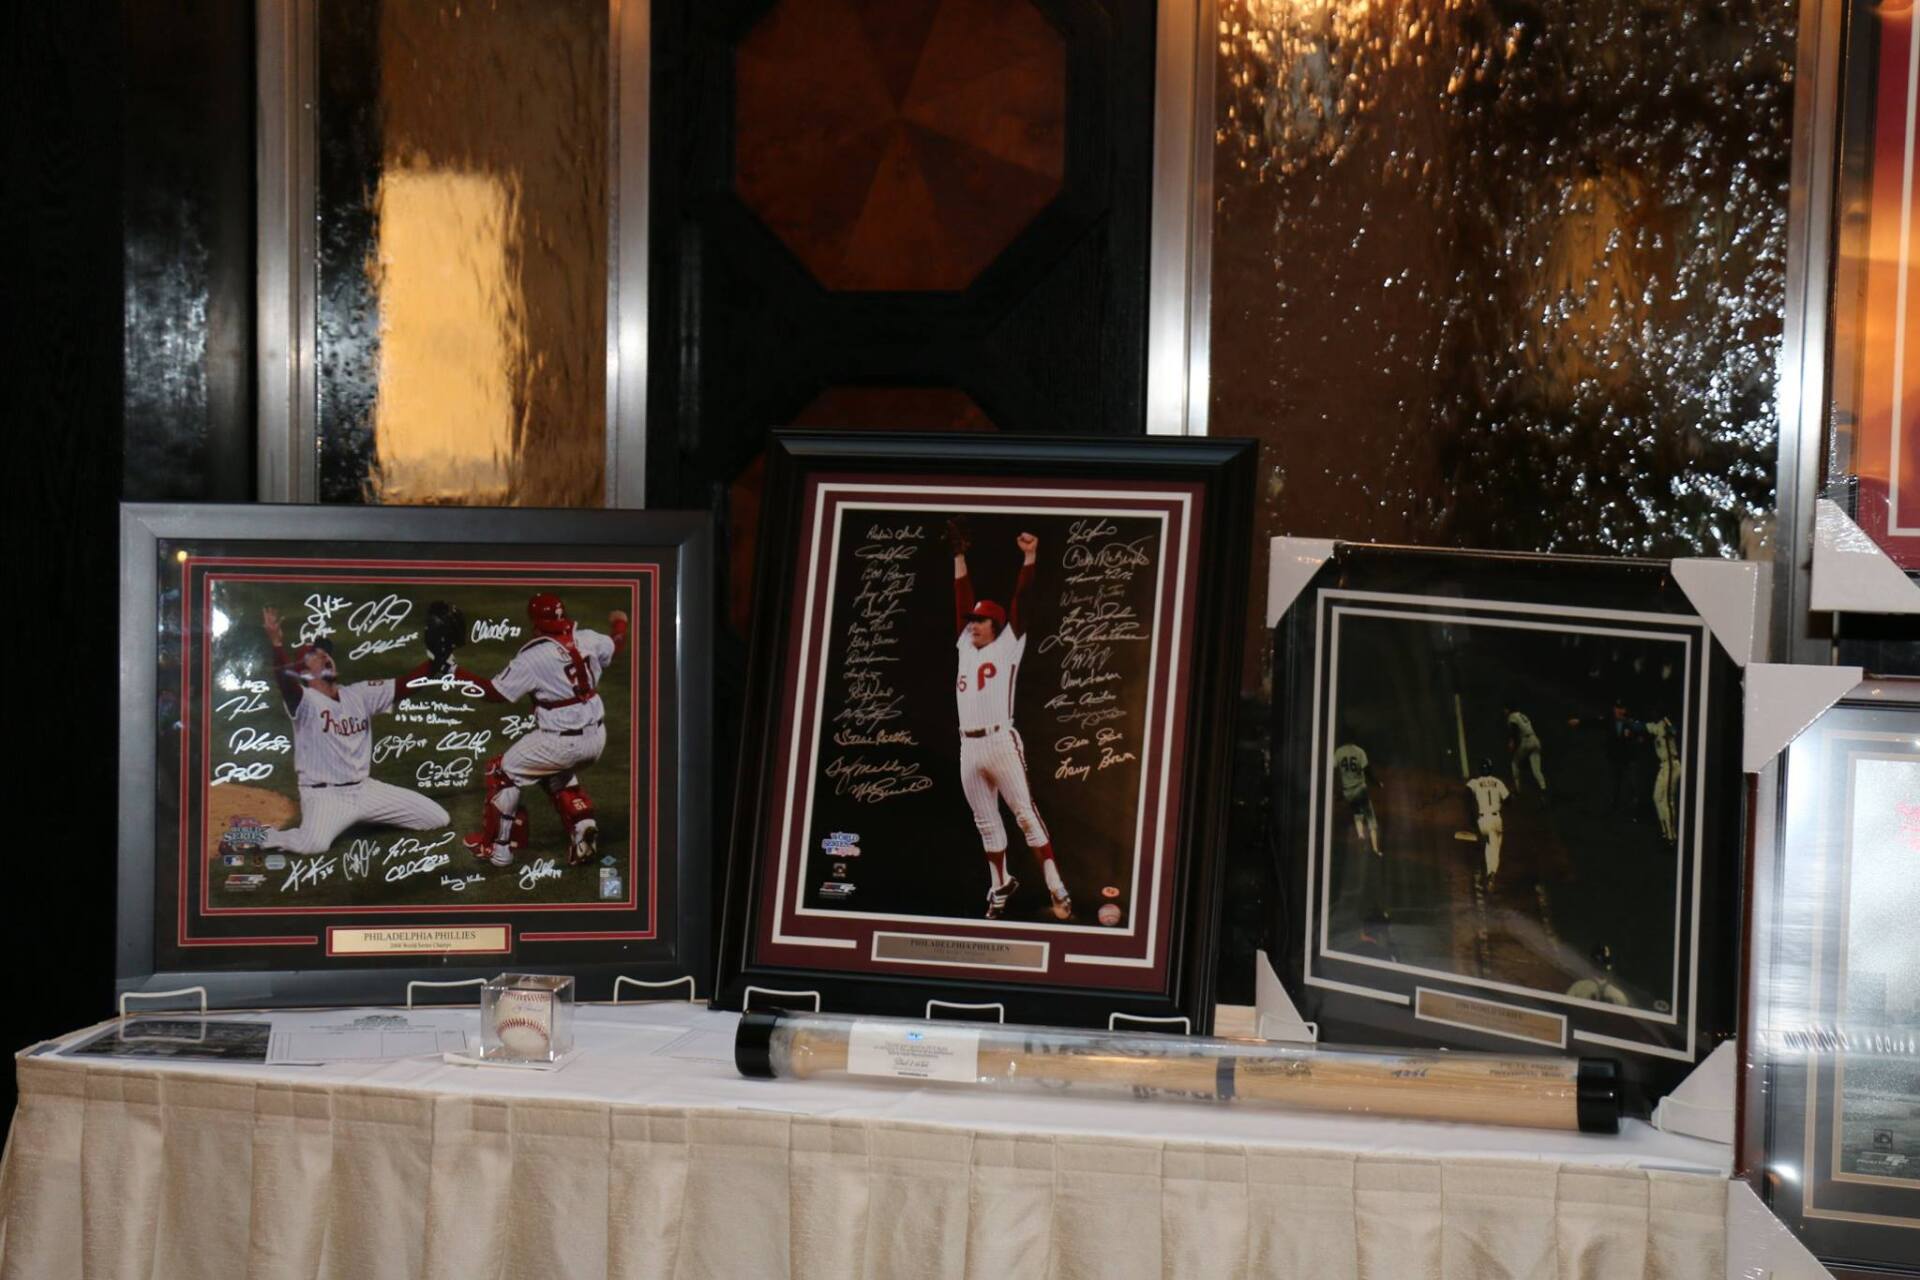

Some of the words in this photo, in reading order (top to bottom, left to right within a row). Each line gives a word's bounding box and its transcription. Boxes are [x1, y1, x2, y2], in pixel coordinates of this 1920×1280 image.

[977, 662, 998, 692] P
[1341, 757, 1357, 773] 46
[1486, 790, 1492, 807] 1
[364, 932, 432, 941] PHILADELPHIA
[435, 931, 476, 940] PHILLIES
[910, 939, 971, 950] PHILADELPHIA
[972, 942, 1010, 952] PHILLIES
